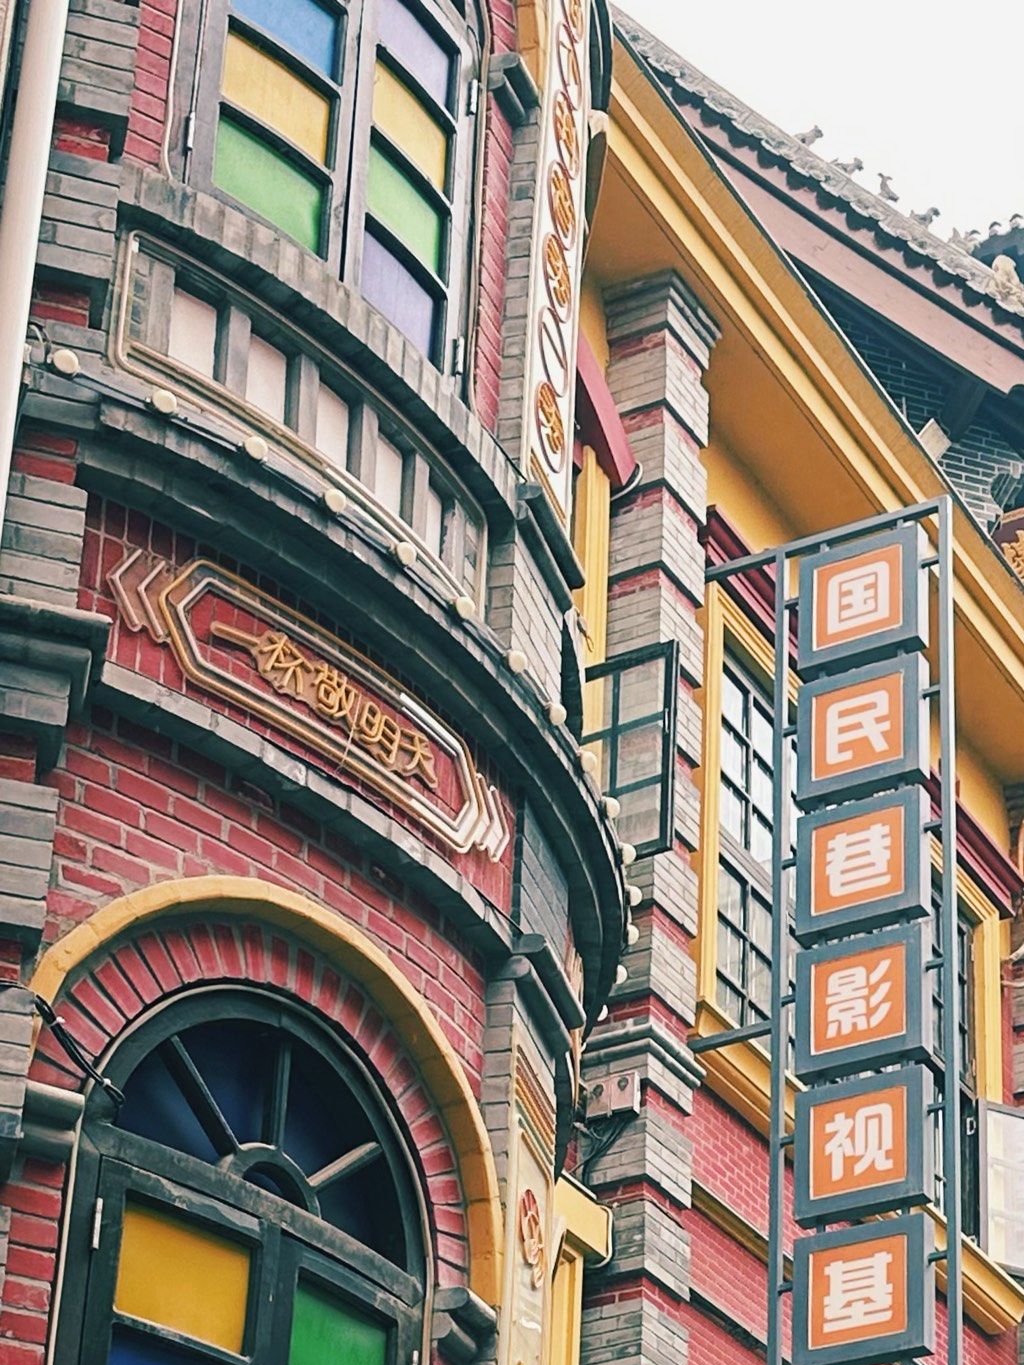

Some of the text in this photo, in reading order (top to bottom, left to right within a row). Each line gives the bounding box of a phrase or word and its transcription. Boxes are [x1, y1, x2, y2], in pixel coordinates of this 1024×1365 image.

[210, 621, 437, 786] 一杯敬明天
